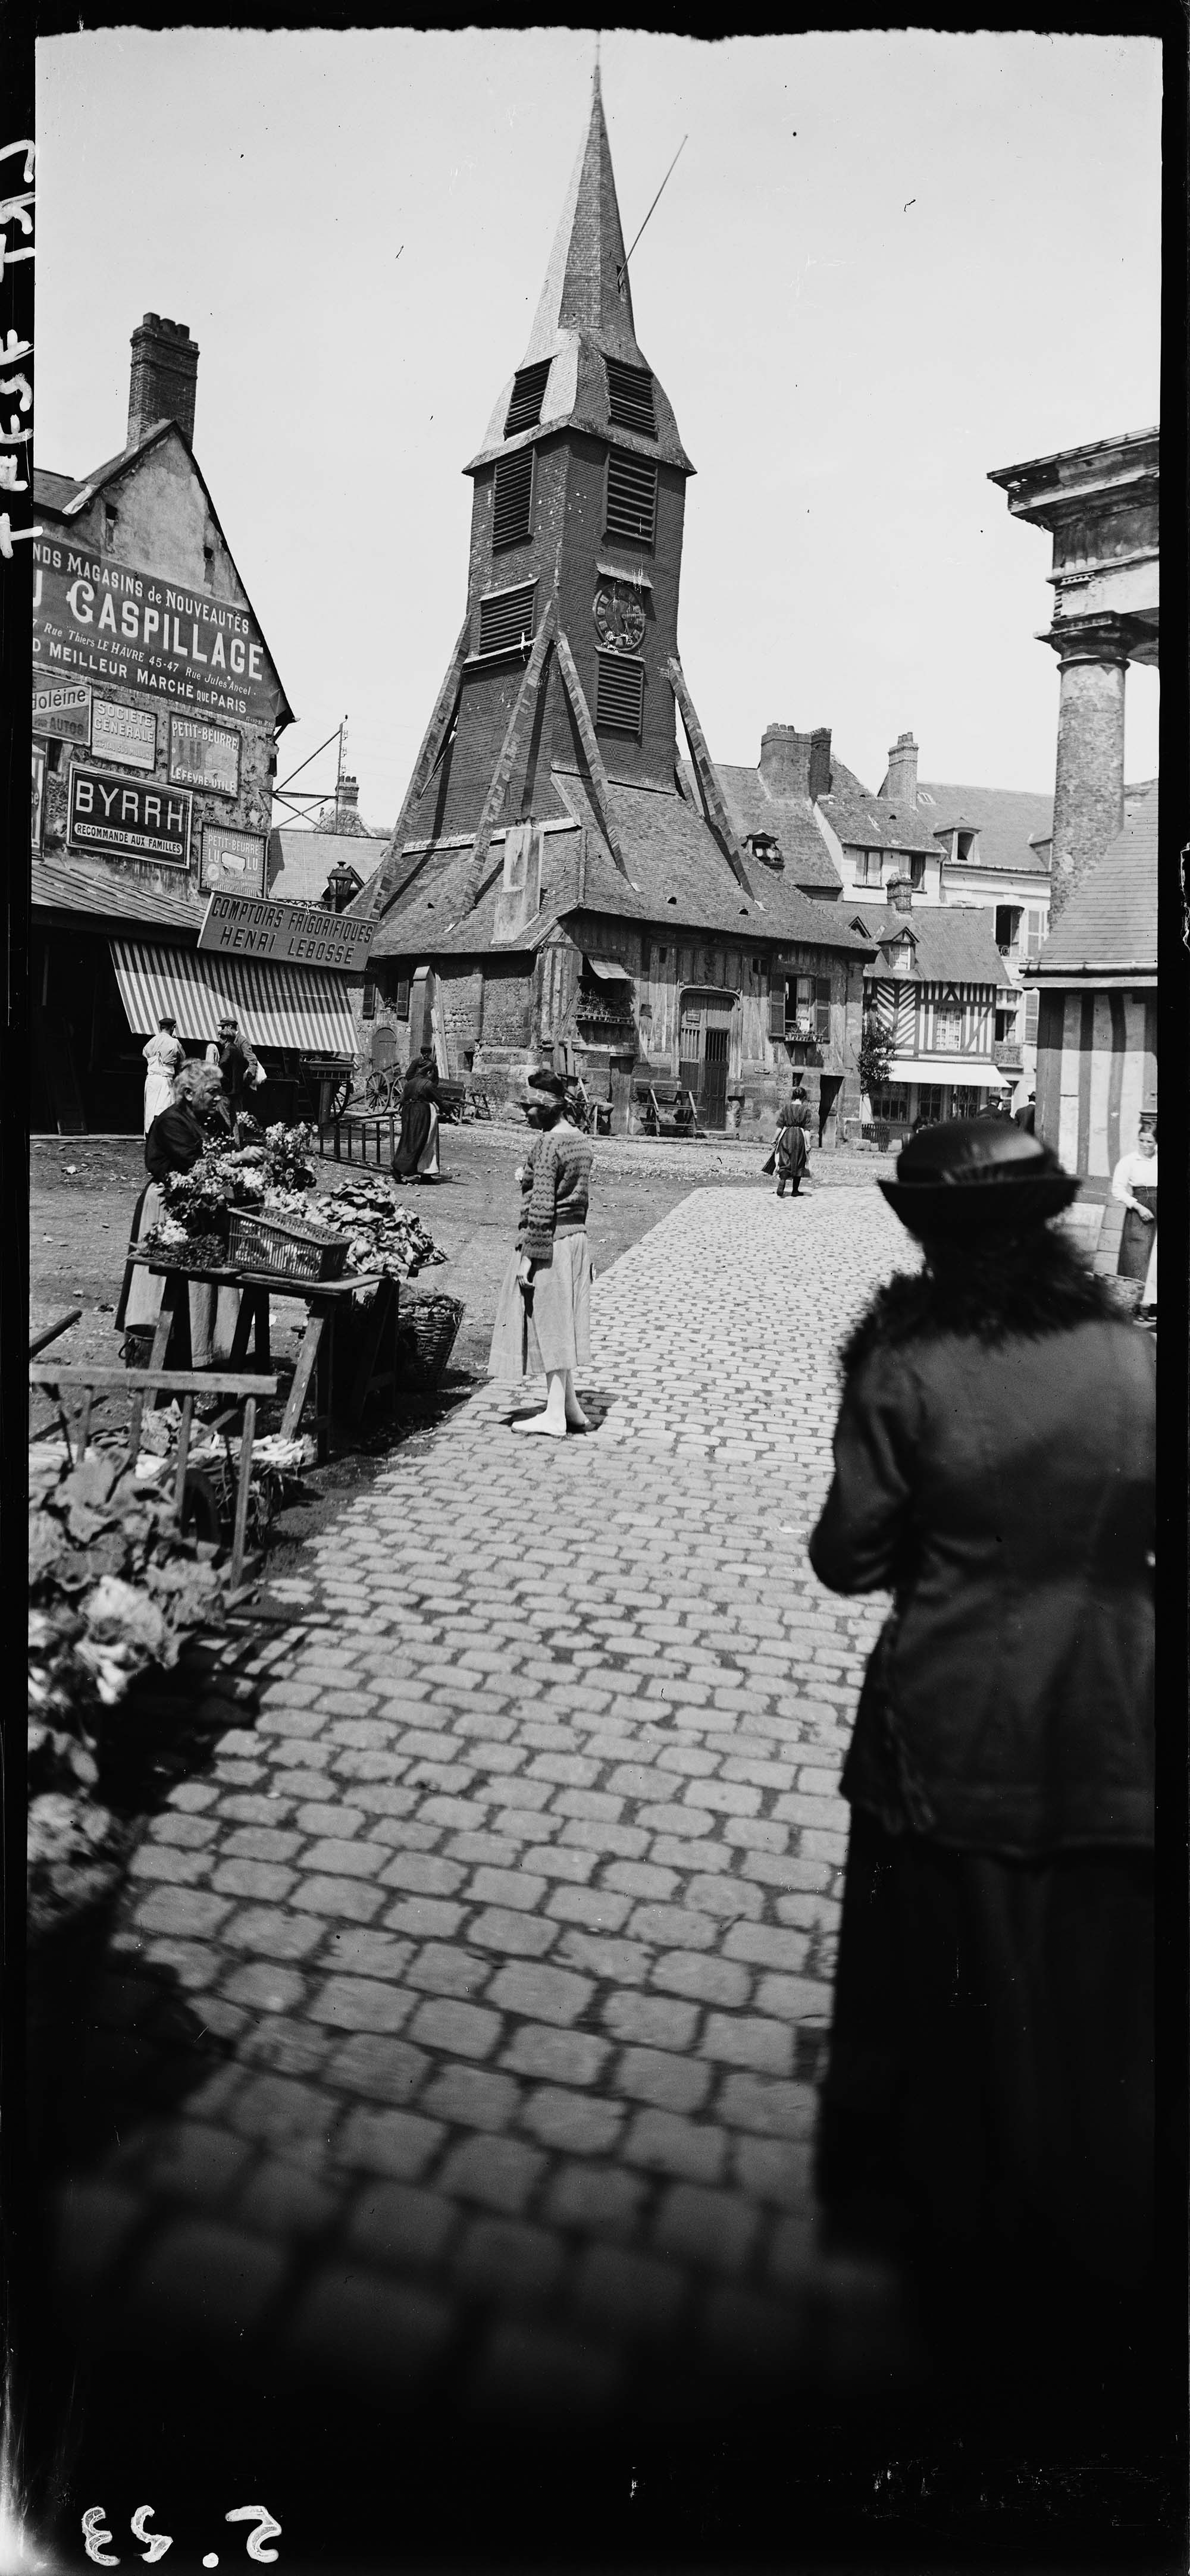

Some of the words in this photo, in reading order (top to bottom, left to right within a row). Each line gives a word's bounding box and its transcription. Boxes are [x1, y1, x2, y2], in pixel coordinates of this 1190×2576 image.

[67, 553, 143, 597] MAGASINS
[148, 586, 162, 604] de
[165, 589, 249, 634] NOUVEAUTÉS
[66, 580, 264, 681] GASPILLAGE
[44, 623, 62, 637] Rue
[68, 630, 95, 647] Thiers
[98, 640, 109, 651] LE
[149, 656, 178, 672] 45-47
[186, 667, 201, 680] Rue
[205, 673, 227, 688] Jules
[228, 681, 250, 695] Ancel
[49, 642, 127, 678] MEILLEUR
[137, 668, 194, 698] MARCHÉ
[196, 690, 209, 703] QUE
[211, 691, 246, 713] PARIS
[172, 721, 237, 752] PETIT-BEURRE
[76, 780, 184, 832] BYRRH
[77, 825, 128, 843] RECOMMANDÉ
[131, 835, 145, 847] AUX
[149, 839, 180, 854] FAMILLES
[208, 835, 258, 855] PETIT-BEURRE
[208, 848, 220, 863] LU
[247, 856, 258, 871] LU
[211, 897, 284, 928] COMPTOIRS
[288, 911, 374, 943] FRIGORIFIQUES
[220, 925, 277, 952] HENRI
